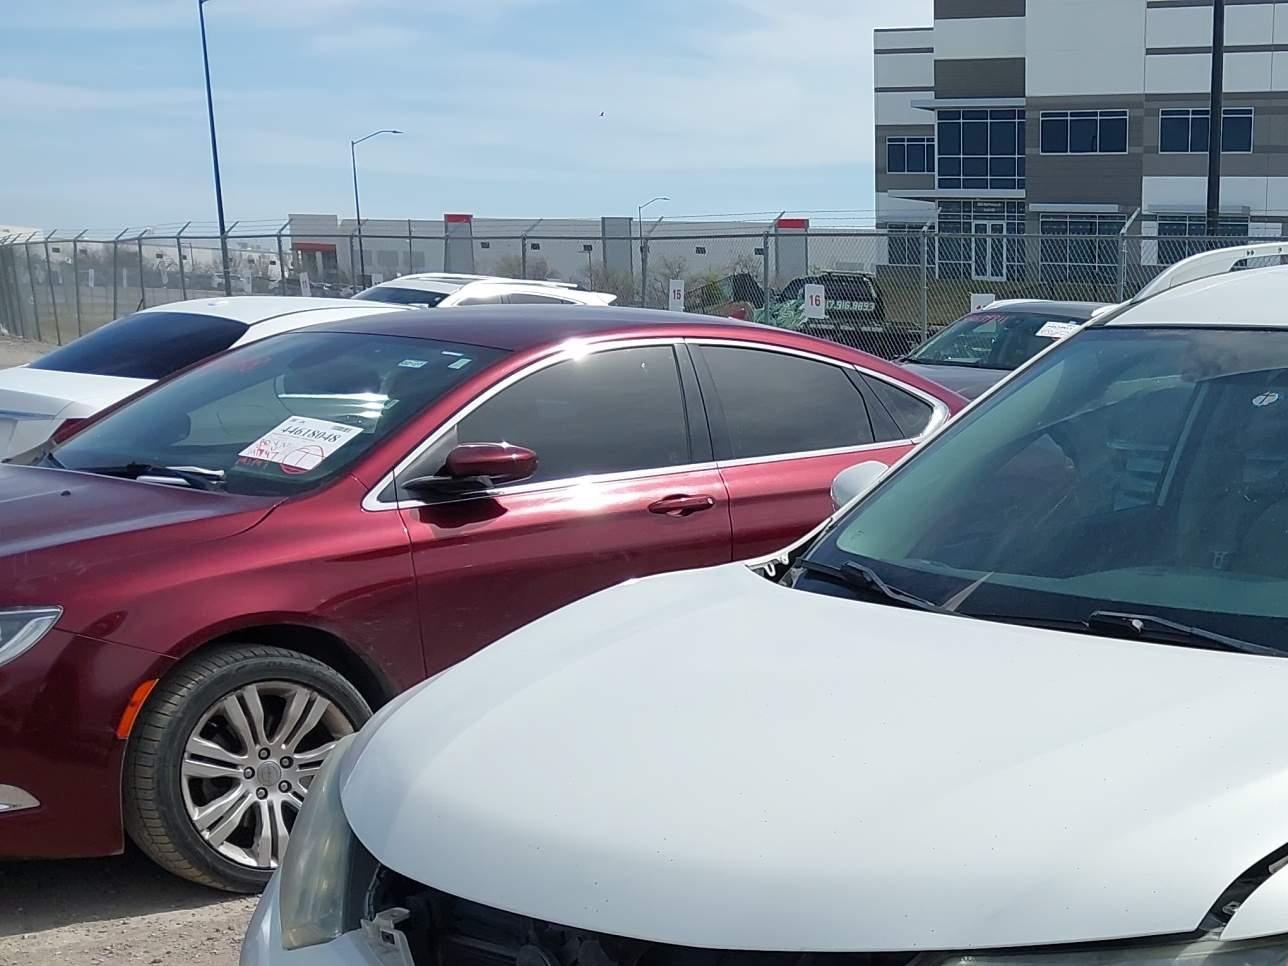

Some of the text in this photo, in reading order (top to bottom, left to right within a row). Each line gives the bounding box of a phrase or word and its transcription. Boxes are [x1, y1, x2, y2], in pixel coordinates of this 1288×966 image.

[672, 289, 682, 300] 15
[809, 294, 821, 307] 16
[282, 426, 342, 443] 44618048
